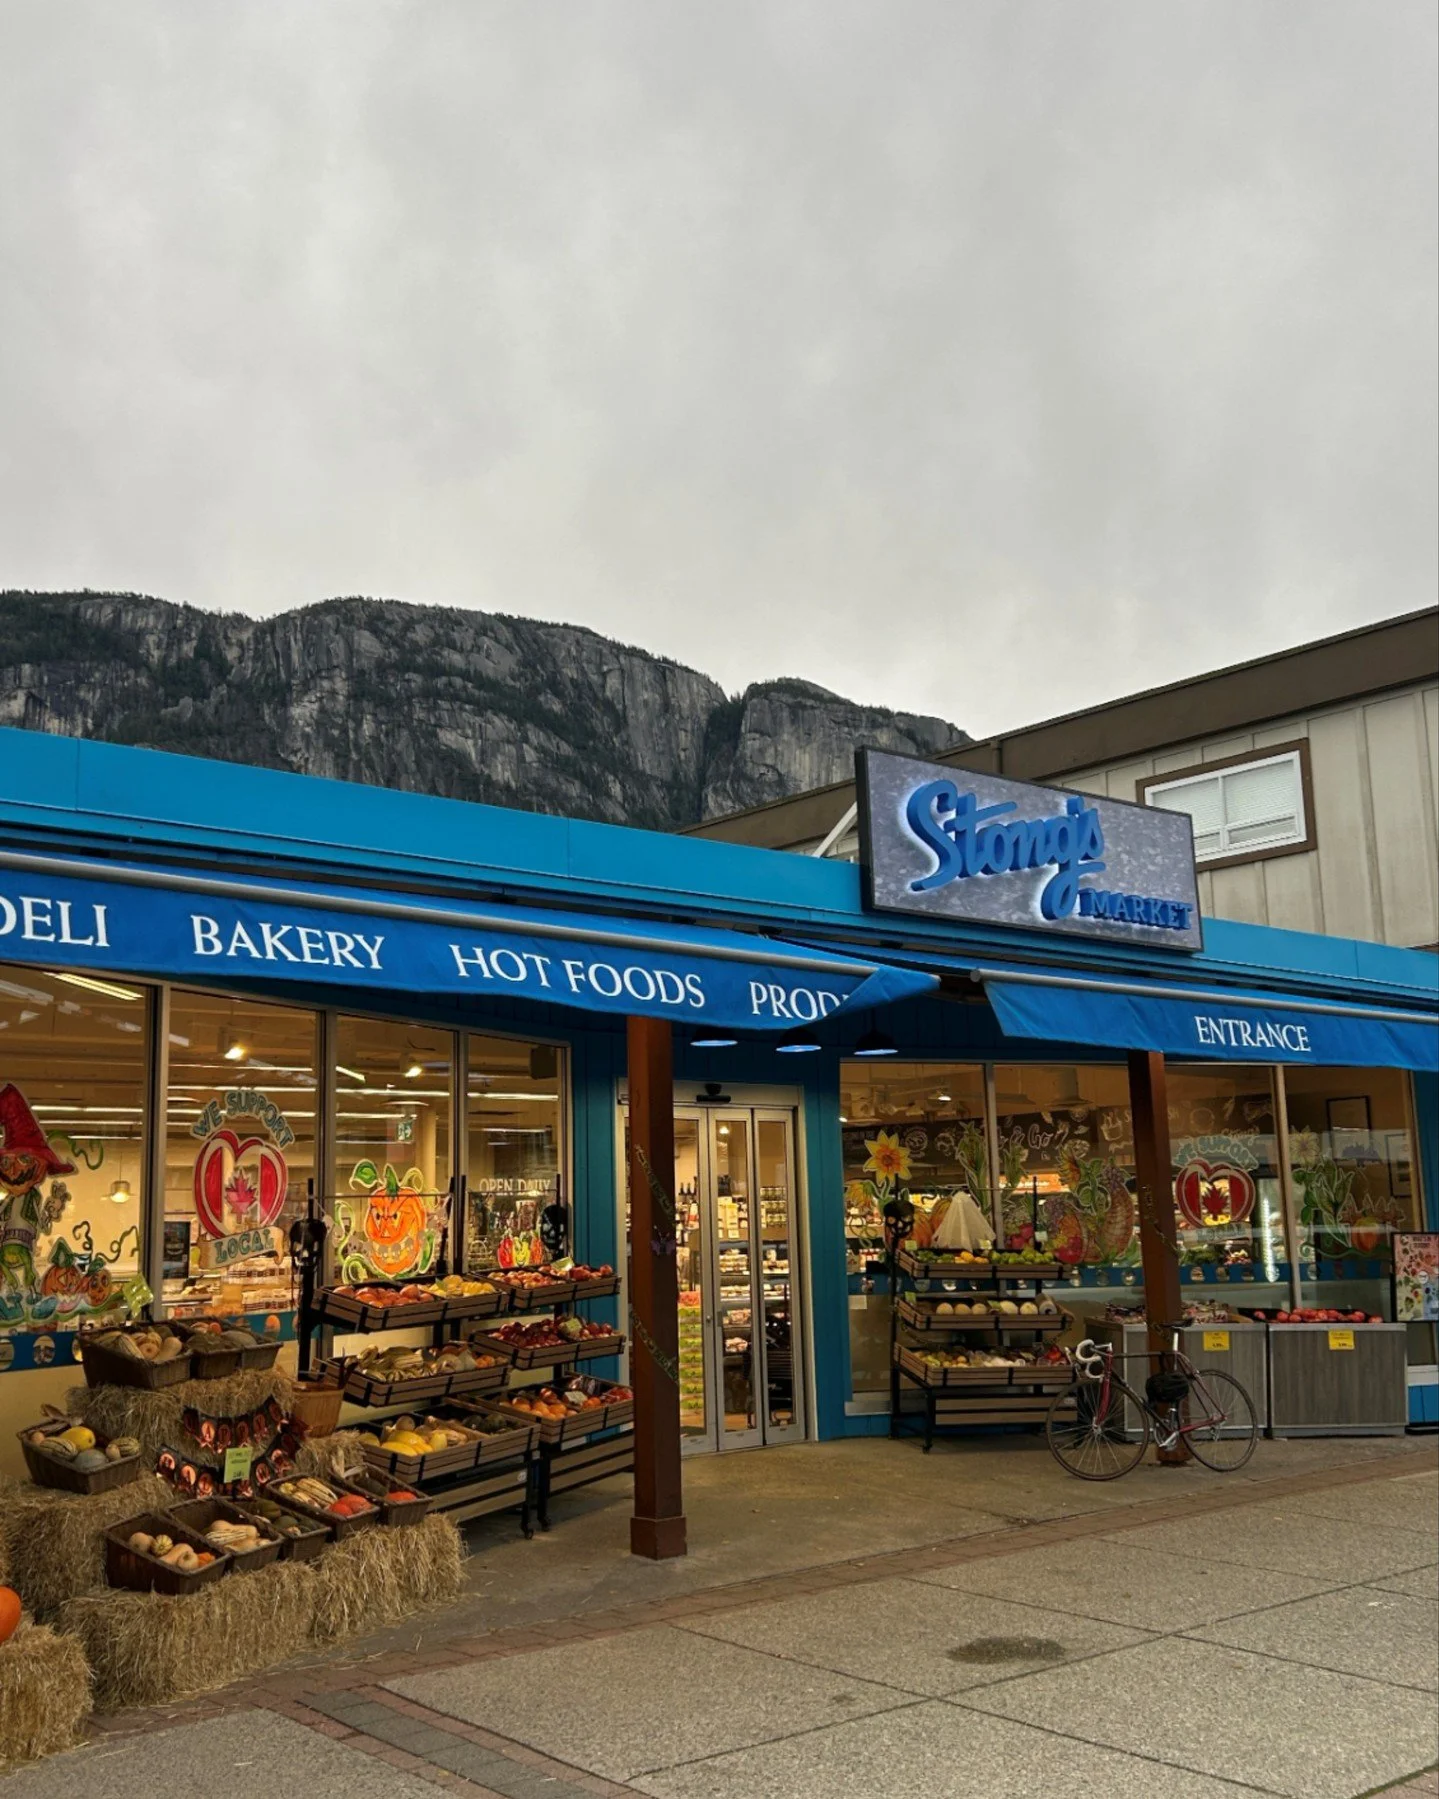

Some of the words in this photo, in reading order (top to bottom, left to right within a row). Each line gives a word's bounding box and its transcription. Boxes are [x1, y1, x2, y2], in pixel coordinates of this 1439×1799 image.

[907, 779, 1106, 921] Stong's
[1079, 888, 1193, 930] MARKET
[190, 914, 385, 970] BAKERY
[449, 944, 552, 989] HOT
[562, 959, 706, 1009] FOODS
[748, 981, 850, 1021] PROD
[1194, 1015, 1312, 1052] ENTRANCE
[191, 1099, 224, 1139] WE
[226, 1091, 295, 1150] SUPPORT
[480, 1178, 513, 1196] OPEN
[213, 1228, 275, 1265] LOCAL
